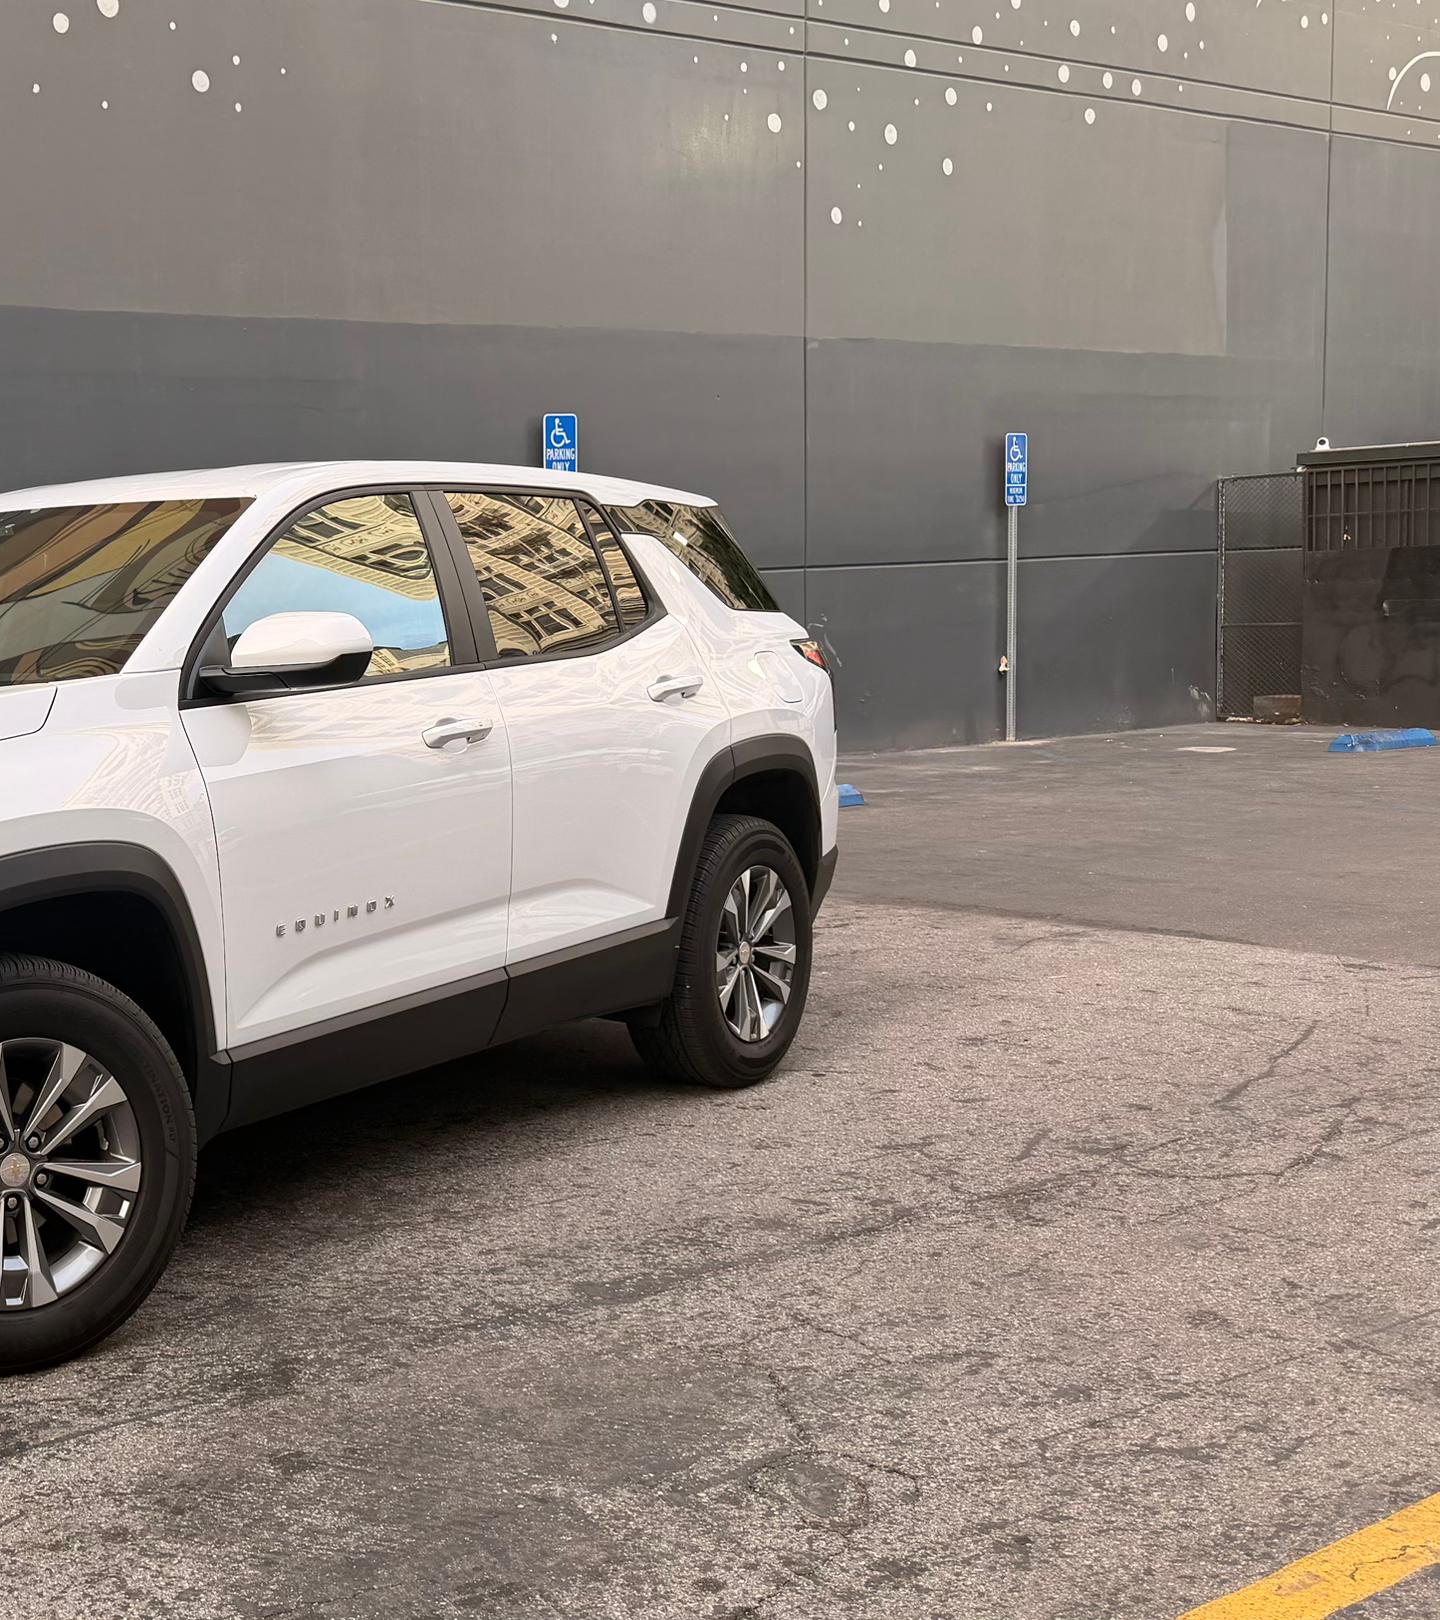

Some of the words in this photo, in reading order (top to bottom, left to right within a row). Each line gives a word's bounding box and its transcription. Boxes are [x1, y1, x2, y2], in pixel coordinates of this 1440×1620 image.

[546, 448, 576, 461] PARKING
[1010, 473, 1023, 484] ONLY
[276, 895, 394, 937] EQUINOX
